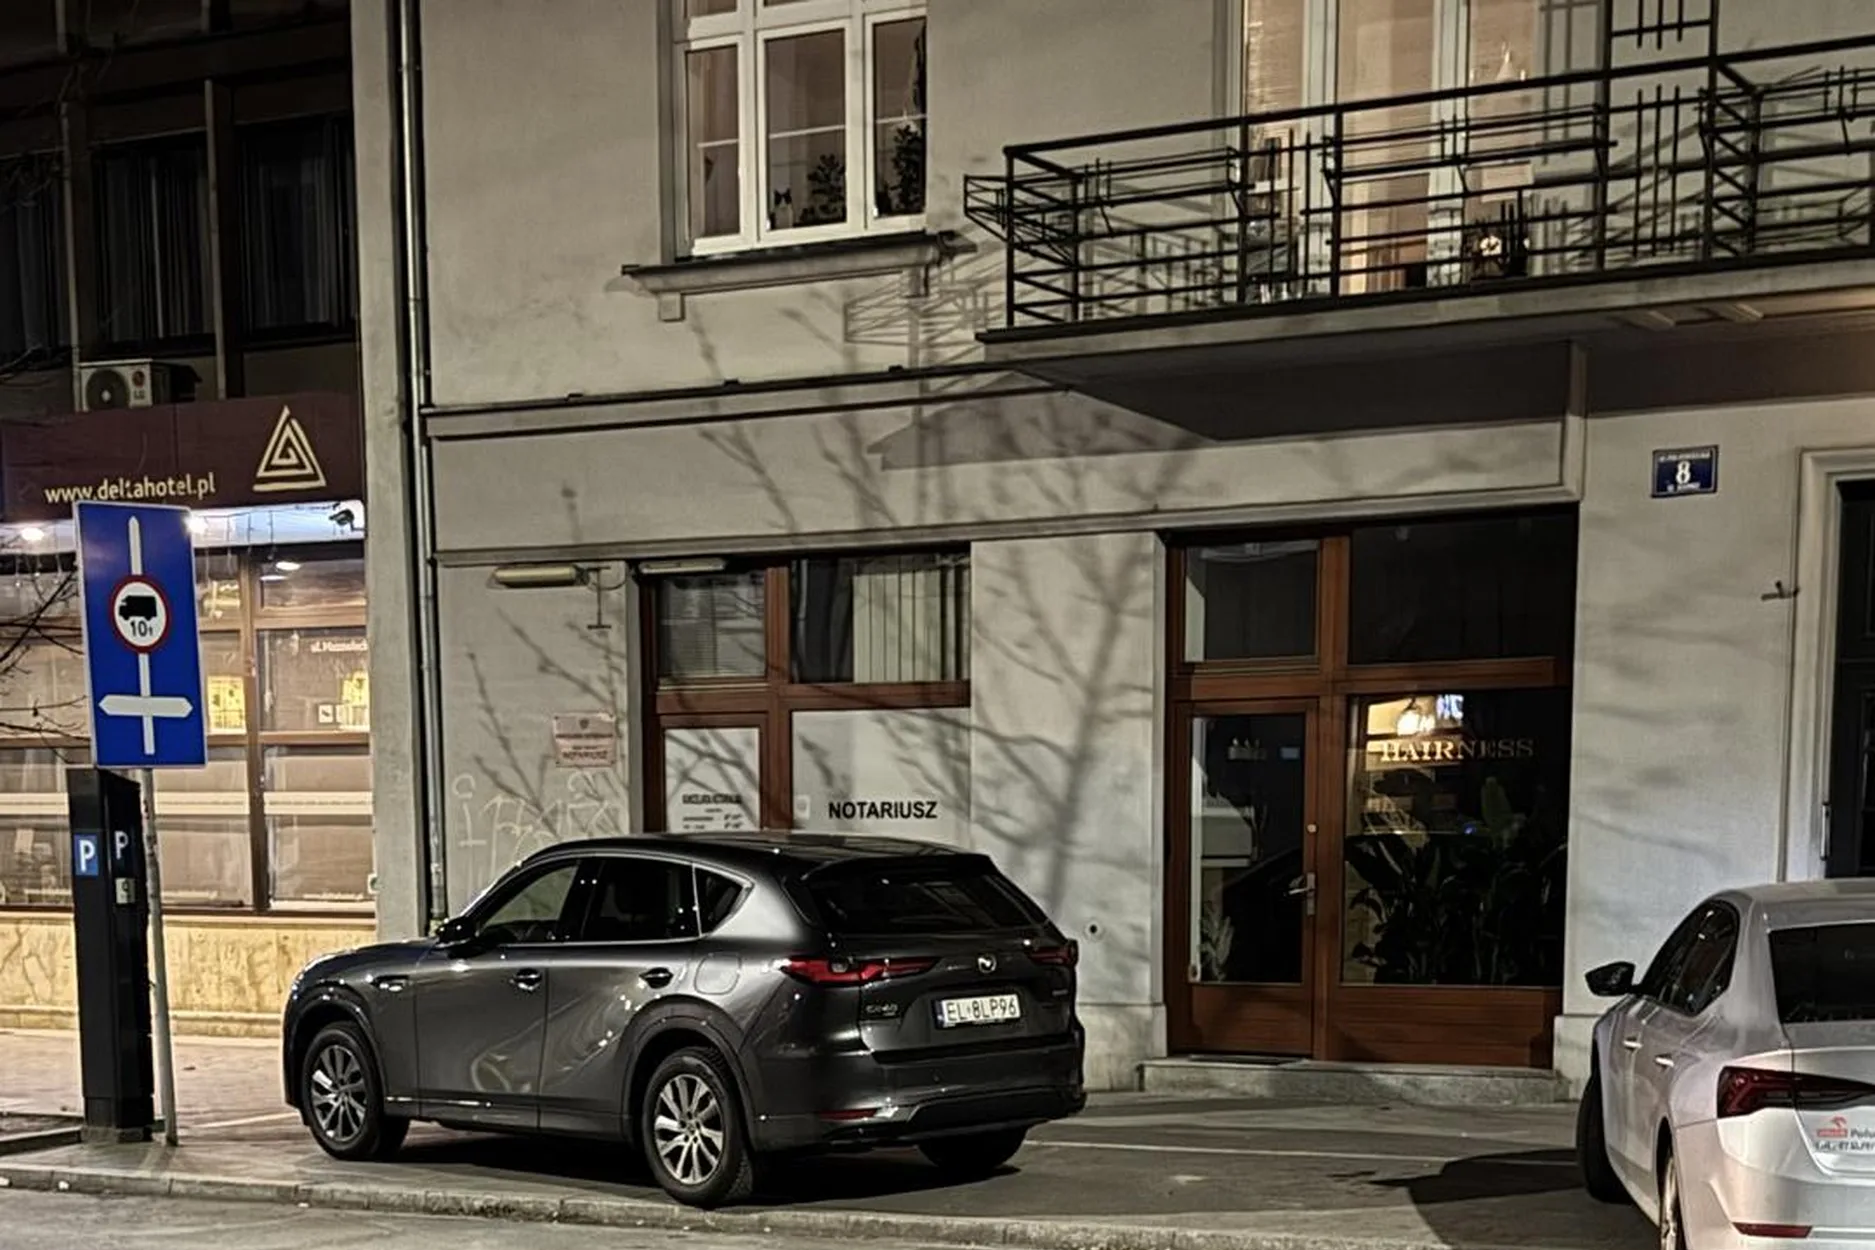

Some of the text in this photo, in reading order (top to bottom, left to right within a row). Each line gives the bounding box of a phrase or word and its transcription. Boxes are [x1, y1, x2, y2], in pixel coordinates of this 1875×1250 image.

[1676, 460, 1691, 485] 8
[44, 471, 216, 503] www.deltahotel.pl
[1380, 736, 1534, 763] HAIRNESS
[828, 801, 938, 819] NOTARIUSZ
[79, 839, 96, 873] P
[114, 830, 129, 860] P
